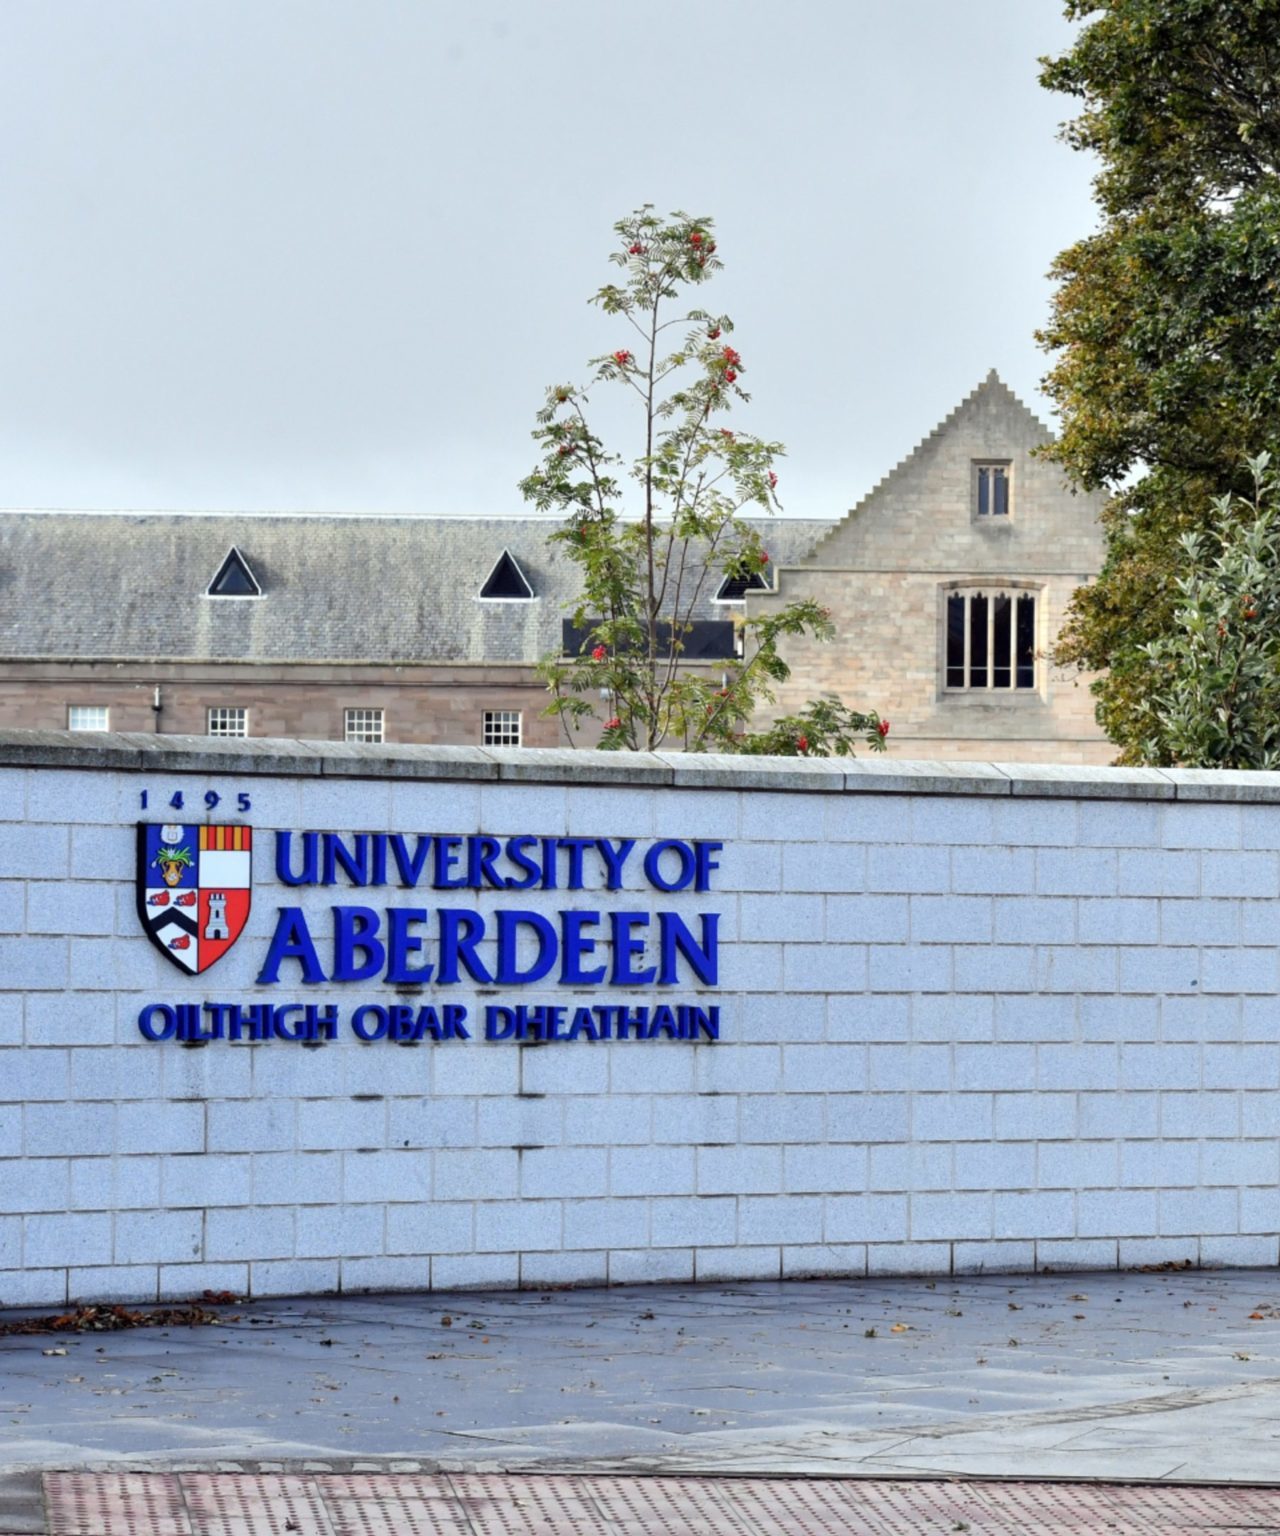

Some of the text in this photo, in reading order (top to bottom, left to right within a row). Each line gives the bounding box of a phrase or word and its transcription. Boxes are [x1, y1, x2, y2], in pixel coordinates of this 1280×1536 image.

[139, 790, 252, 812] 1495
[275, 831, 724, 892] UNIVERSITY OF
[256, 905, 722, 986] ABERDEEN
[137, 1002, 721, 1042] OILTHIGH OBAR DHEATHAIN
